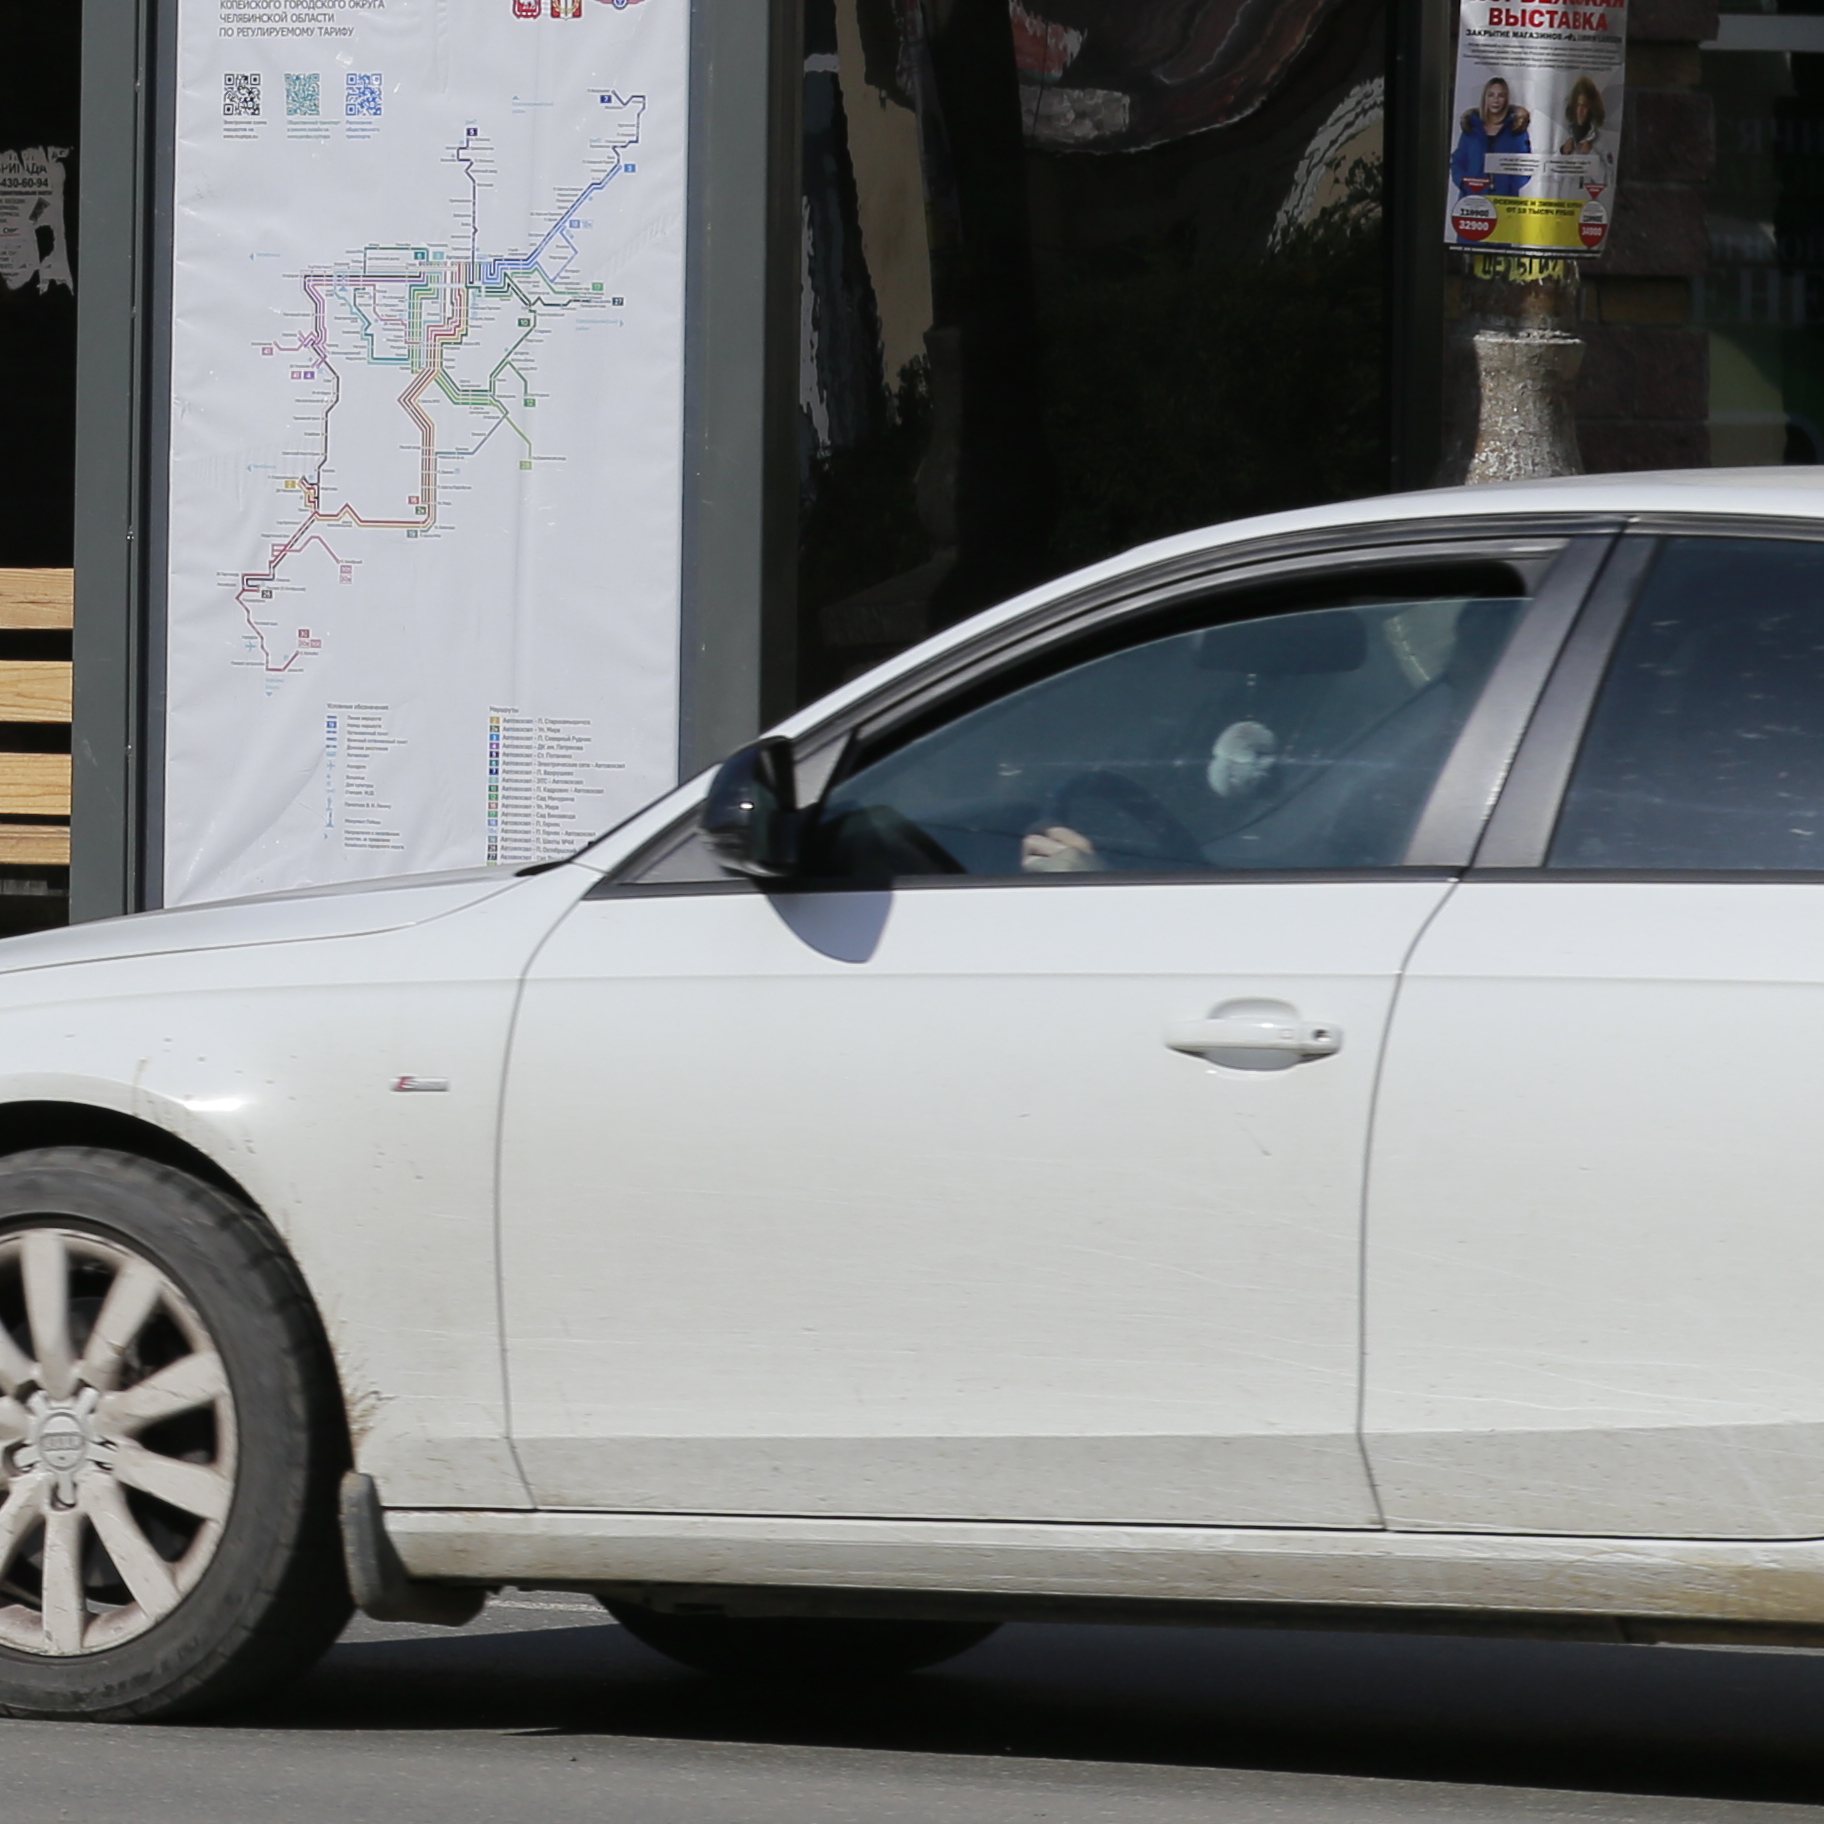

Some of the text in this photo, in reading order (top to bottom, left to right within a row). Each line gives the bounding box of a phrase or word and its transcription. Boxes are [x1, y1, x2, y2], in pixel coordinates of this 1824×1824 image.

[284, 0, 346, 10] ГОРОДСКОГО
[348, 0, 385, 9] ОКРУГА
[220, 11, 335, 23] ЧЕЛЯБИНСКОЙ ОБЛАСТИ
[1488, 7, 1609, 32] ВЫСТАВКА
[219, 27, 355, 37] ПО РЕГУЛИРУЕМОМУ ТАРИФУ
[1466, 29, 1562, 41] ЗАКРЫТИЕ МАГАЗИНОВ
[1458, 219, 1490, 231] 32900
